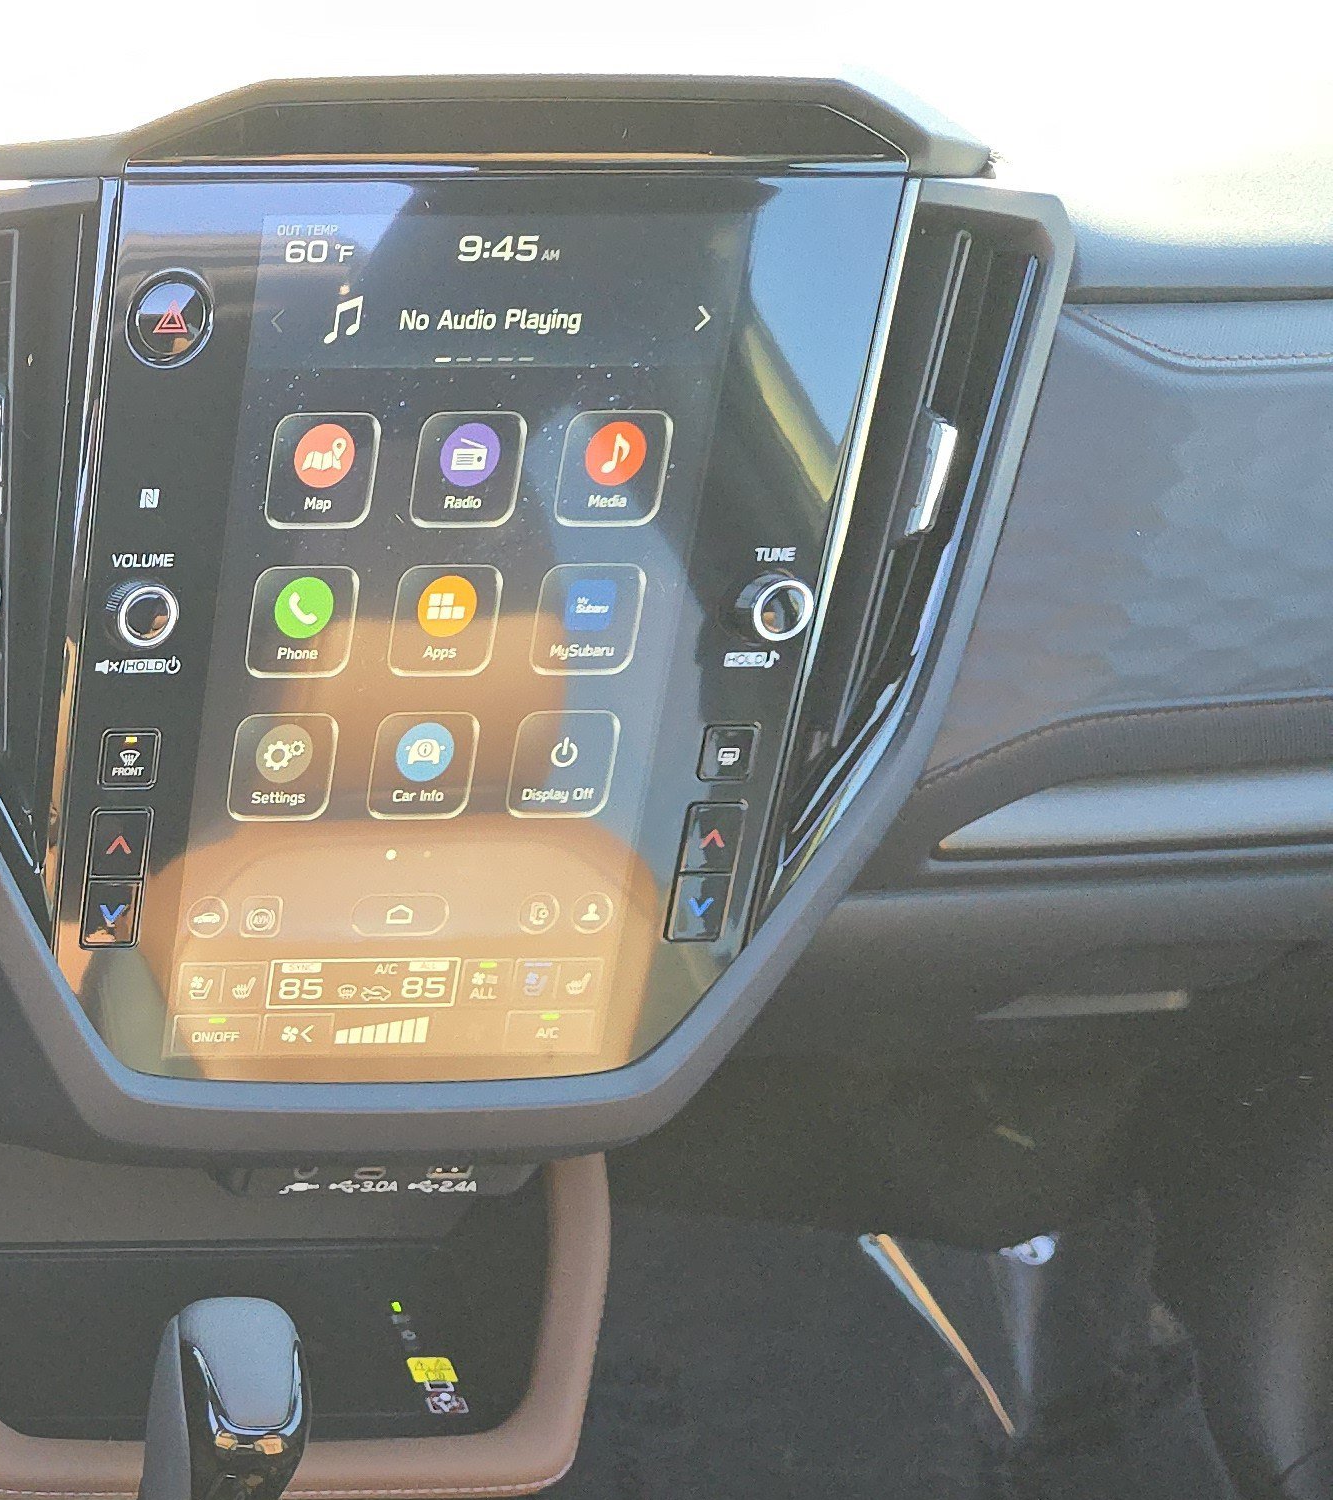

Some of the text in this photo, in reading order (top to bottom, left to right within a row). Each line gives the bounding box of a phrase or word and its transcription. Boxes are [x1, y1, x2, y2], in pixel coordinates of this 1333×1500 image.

[277, 224, 339, 236] OUT TEMP
[284, 240, 329, 263] 60
[457, 235, 560, 262] 9:45 AM
[399, 308, 583, 335] No Audio Playing
[303, 496, 332, 513] Map
[443, 495, 482, 510] Radio
[587, 494, 628, 508] Media
[111, 553, 175, 568] VOLUME
[755, 547, 797, 562] TUNE
[277, 647, 319, 661] Phone
[422, 645, 458, 661] Apps
[549, 643, 615, 661] MySubaru
[125, 660, 165, 672] HOLD
[112, 766, 144, 777] FRONT
[250, 790, 306, 807] Settings
[392, 789, 445, 803] Car Info
[521, 787, 595, 804] Display Off
[374, 963, 399, 974] A/C
[278, 978, 325, 1000] 85
[400, 976, 447, 999] 85
[469, 987, 498, 1000] ALL
[191, 1031, 241, 1043] ON/OFF
[535, 1026, 561, 1039] A/C
